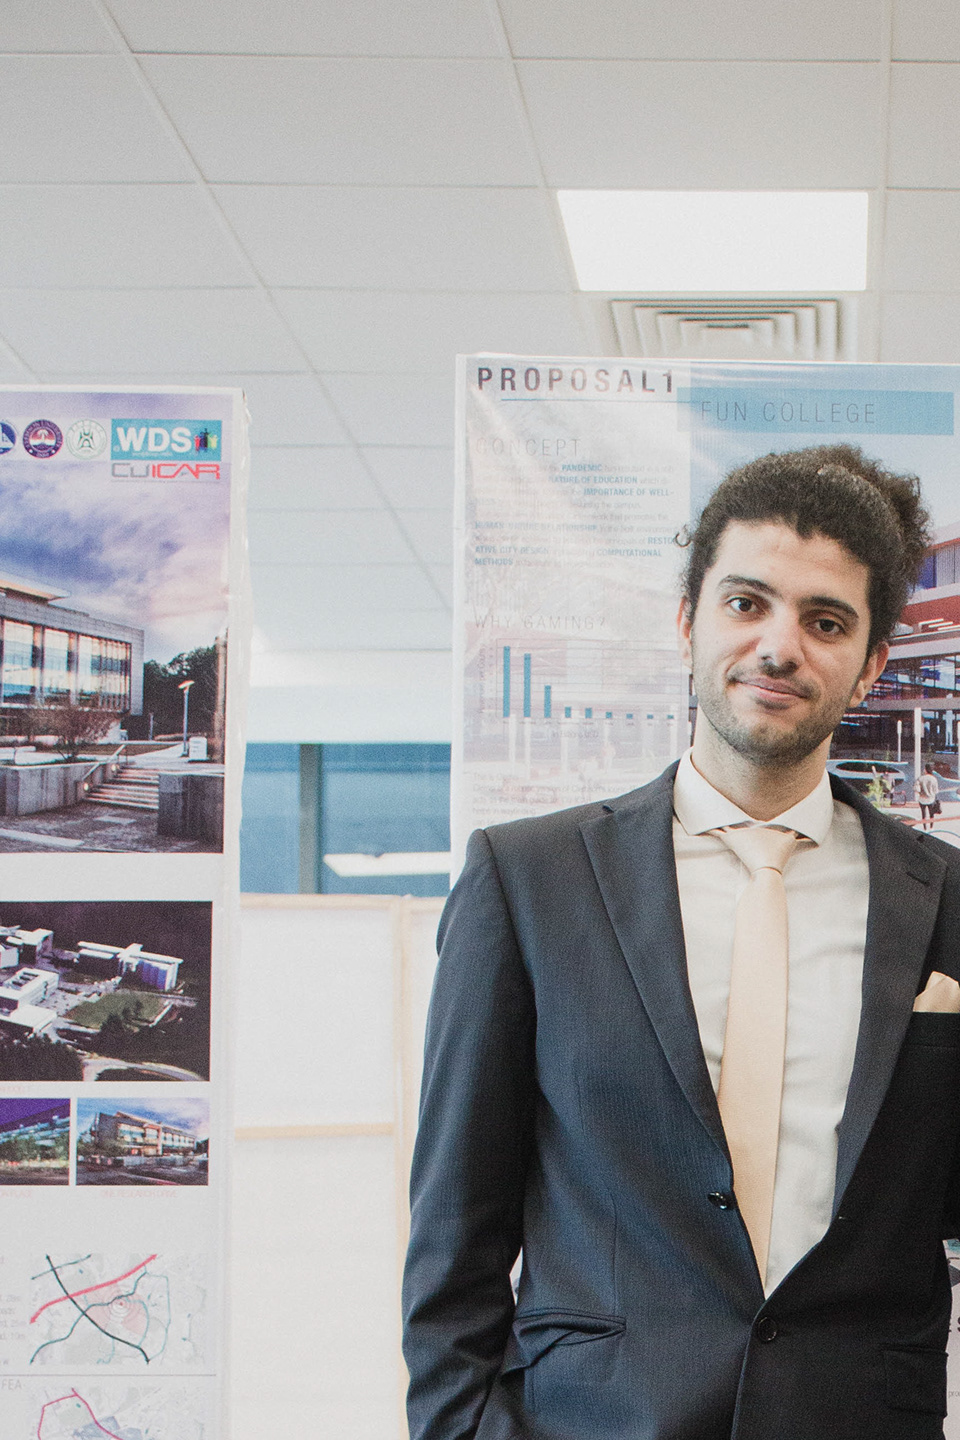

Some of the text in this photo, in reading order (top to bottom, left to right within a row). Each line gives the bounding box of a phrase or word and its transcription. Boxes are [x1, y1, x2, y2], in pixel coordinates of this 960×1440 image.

[701, 401, 876, 423] FUN COLLEGE
[116, 427, 192, 453] WDS
[475, 438, 582, 457] CONCEPT
[562, 464, 602, 472] PANDEMIC
[593, 476, 637, 484] EDUCATION
[584, 488, 633, 496] IMPORTANCE
[636, 488, 646, 496] OF
[648, 536, 676, 544] RESTO
[597, 549, 662, 557] COMPUTATIONAL
[475, 615, 511, 629] WHY
